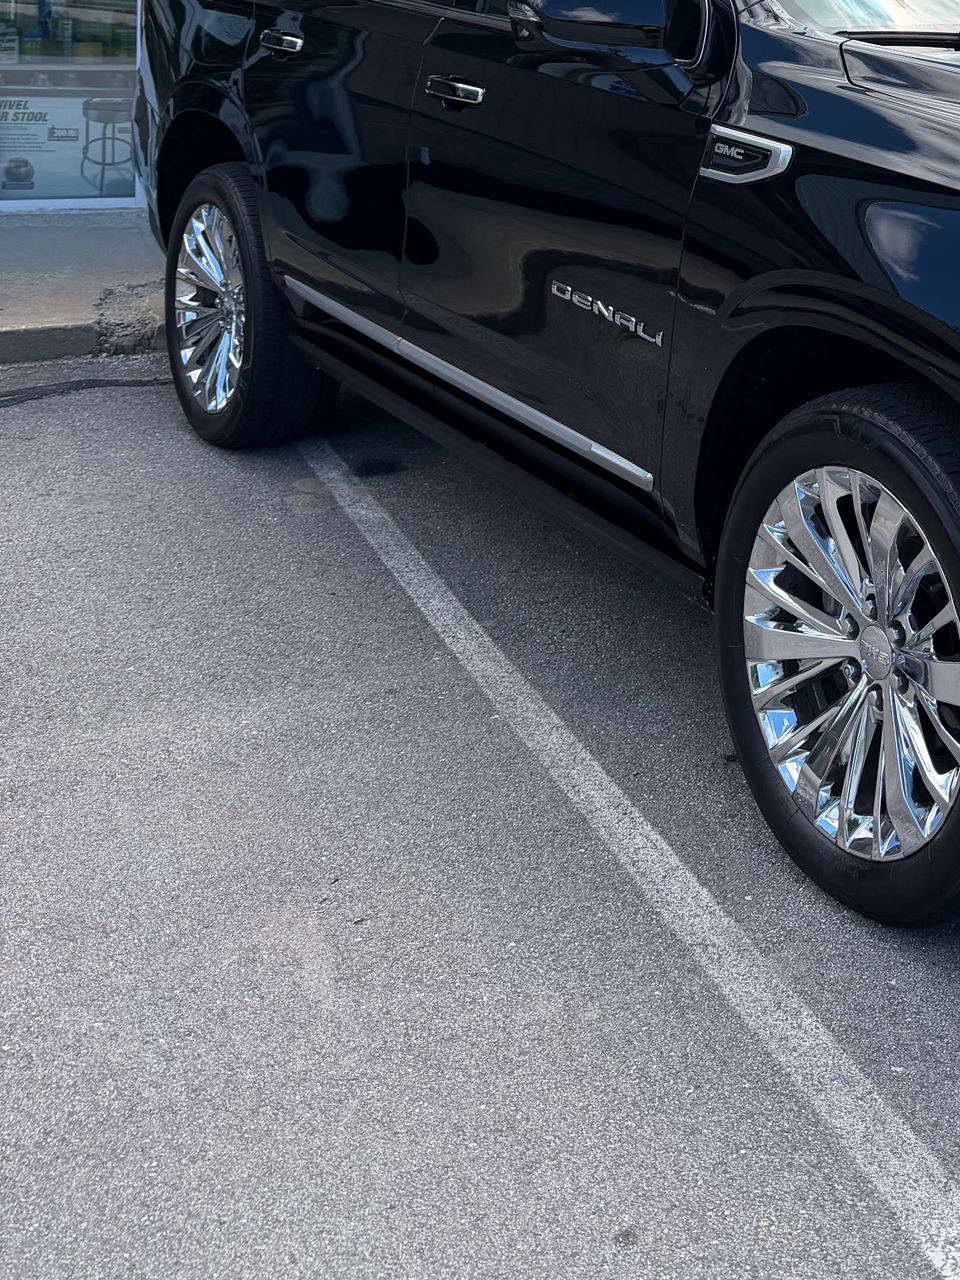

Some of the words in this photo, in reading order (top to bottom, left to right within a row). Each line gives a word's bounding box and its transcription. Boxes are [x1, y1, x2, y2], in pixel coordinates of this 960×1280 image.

[0, 99, 29, 110] IVEL
[11, 111, 48, 122] STOOL
[714, 142, 745, 160] GMC
[551, 279, 663, 348] DENALI
